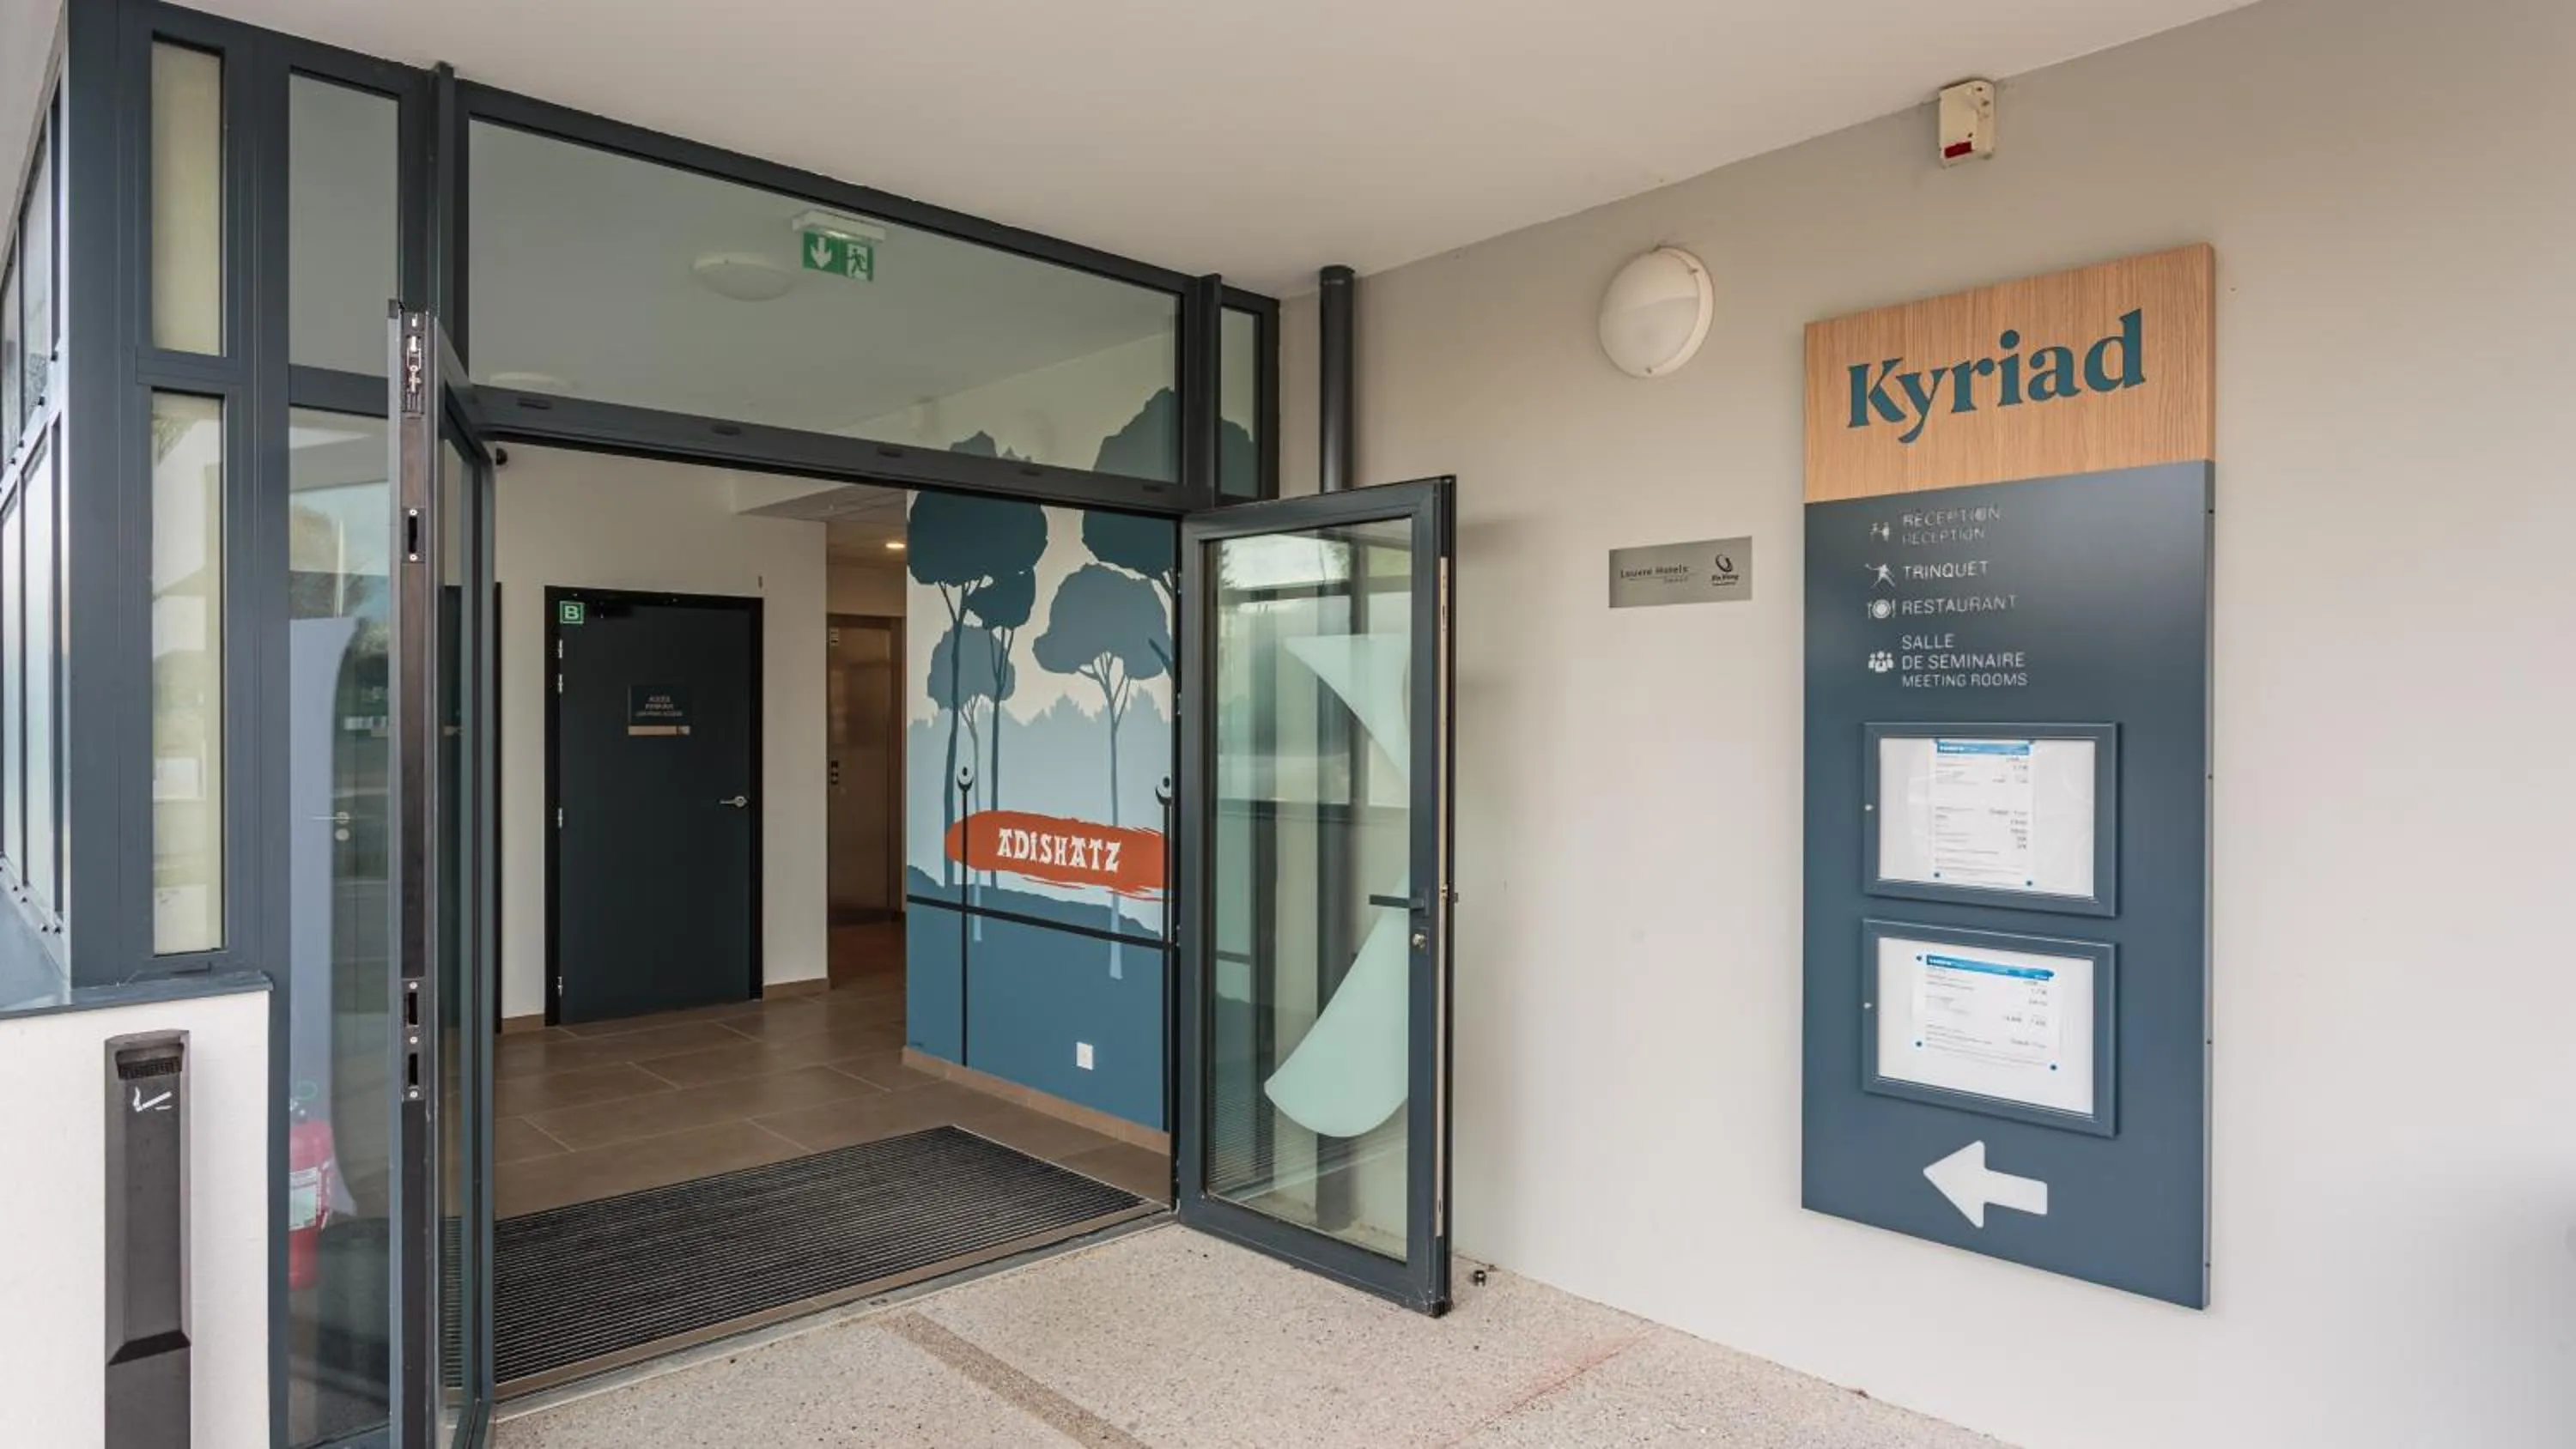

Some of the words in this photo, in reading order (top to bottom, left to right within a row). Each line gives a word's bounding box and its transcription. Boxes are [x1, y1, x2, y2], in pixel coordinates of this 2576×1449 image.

[1847, 307, 2147, 444] Kyriad
[1903, 561, 1989, 580] TRINQUET
[565, 605, 580, 620] B
[1902, 595, 2017, 615] RESTAURANT
[1902, 634, 1956, 650] SALLE
[1902, 655, 1924, 670] DE
[1928, 652, 2026, 670] SEMINAIRE
[1902, 675, 1966, 688] MEETING
[1971, 672, 2028, 687] ROOMS
